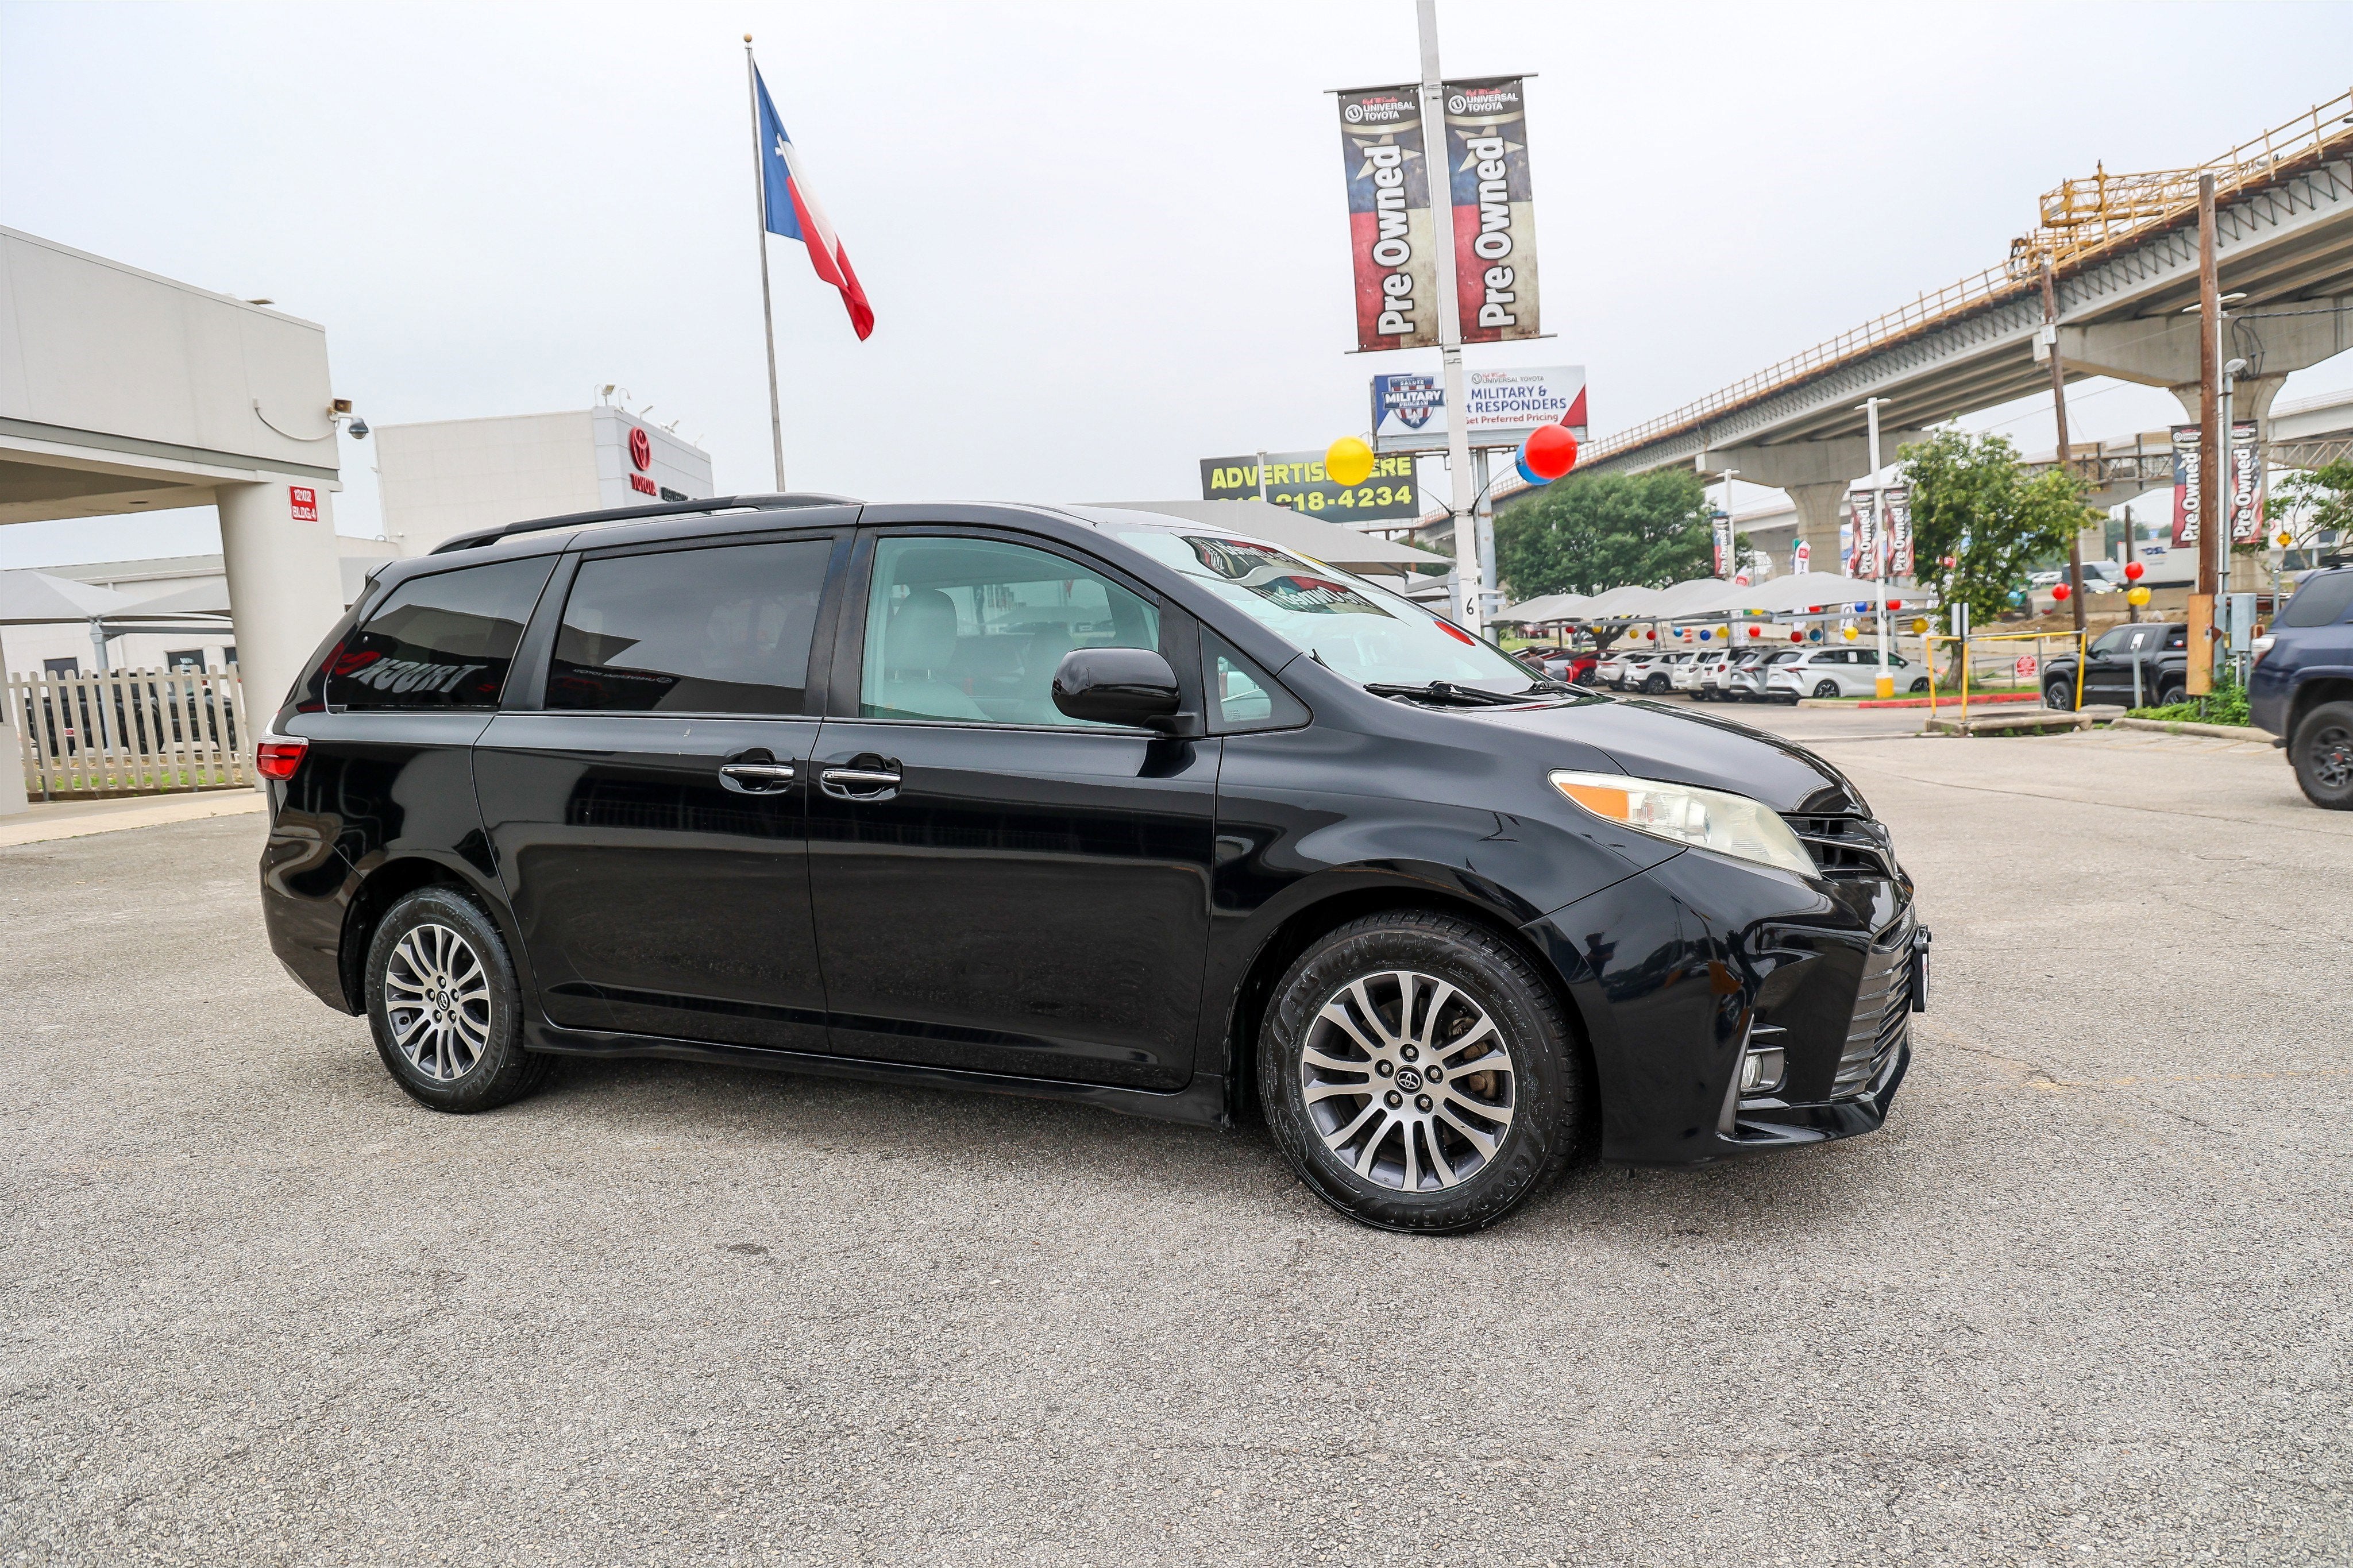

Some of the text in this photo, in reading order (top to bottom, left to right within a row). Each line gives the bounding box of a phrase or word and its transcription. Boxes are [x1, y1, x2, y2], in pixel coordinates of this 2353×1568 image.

[1363, 101, 1415, 113] UNIVERSAL
[1467, 92, 1518, 103] UNIVERSAL
[1467, 101, 1503, 113] TOYOTA
[1364, 110, 1399, 122] TOYOTA
[1364, 145, 1411, 267] Owned
[1467, 137, 1512, 259] Owned
[1378, 274, 1414, 335] Pre
[1479, 267, 1515, 327] Pre
[1385, 390, 1441, 404] MILITARY
[1399, 399, 1429, 407] PROGRAM
[1471, 385, 1547, 400] MILITARY &
[1476, 397, 1567, 413] RESPONDERS
[1481, 414, 1524, 423] Preferred
[1526, 412, 1559, 423] Pricing
[1367, 457, 1411, 478] ERE
[2233, 449, 2252, 507] Owned
[630, 473, 657, 496] TOYOTA
[2181, 453, 2200, 511] Owned
[294, 489, 313, 503] 12102
[1857, 509, 1872, 551] Owned
[1891, 508, 1905, 550] Owned
[2181, 512, 2199, 541] Pre
[2233, 509, 2252, 537] Pre
[1718, 530, 1728, 559] Owned
[1718, 559, 1728, 574] Pre
[1858, 553, 1872, 573] Pre
[1892, 551, 1906, 572] Pre
[1466, 597, 1474, 615] 6
[1386, 1153, 1532, 1227] GOODYEAR
